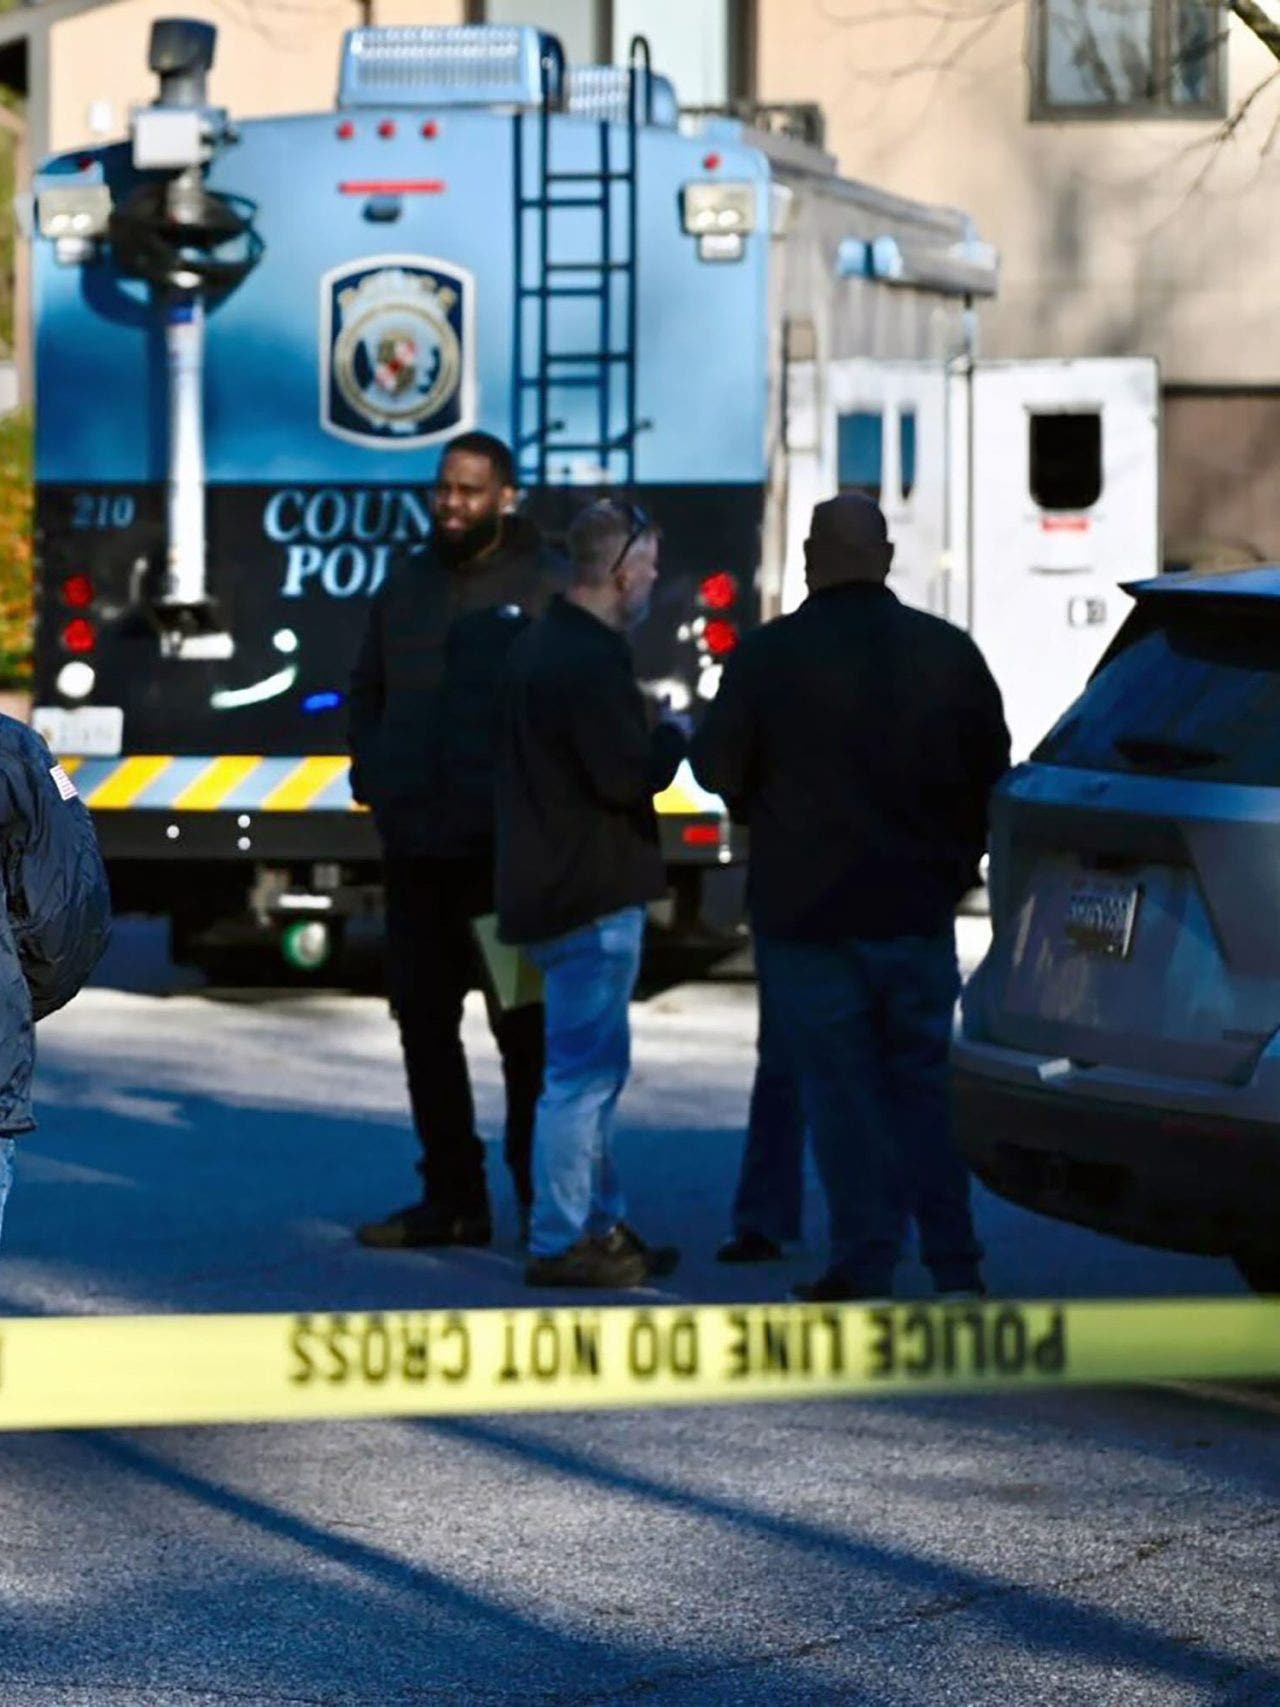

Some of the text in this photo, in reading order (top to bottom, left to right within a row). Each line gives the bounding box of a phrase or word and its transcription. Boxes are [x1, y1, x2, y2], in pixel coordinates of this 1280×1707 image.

[71, 492, 136, 530] 210
[263, 488, 431, 542] COUN
[289, 1307, 1065, 1384] POLICE LINE DO NOT CROSS
